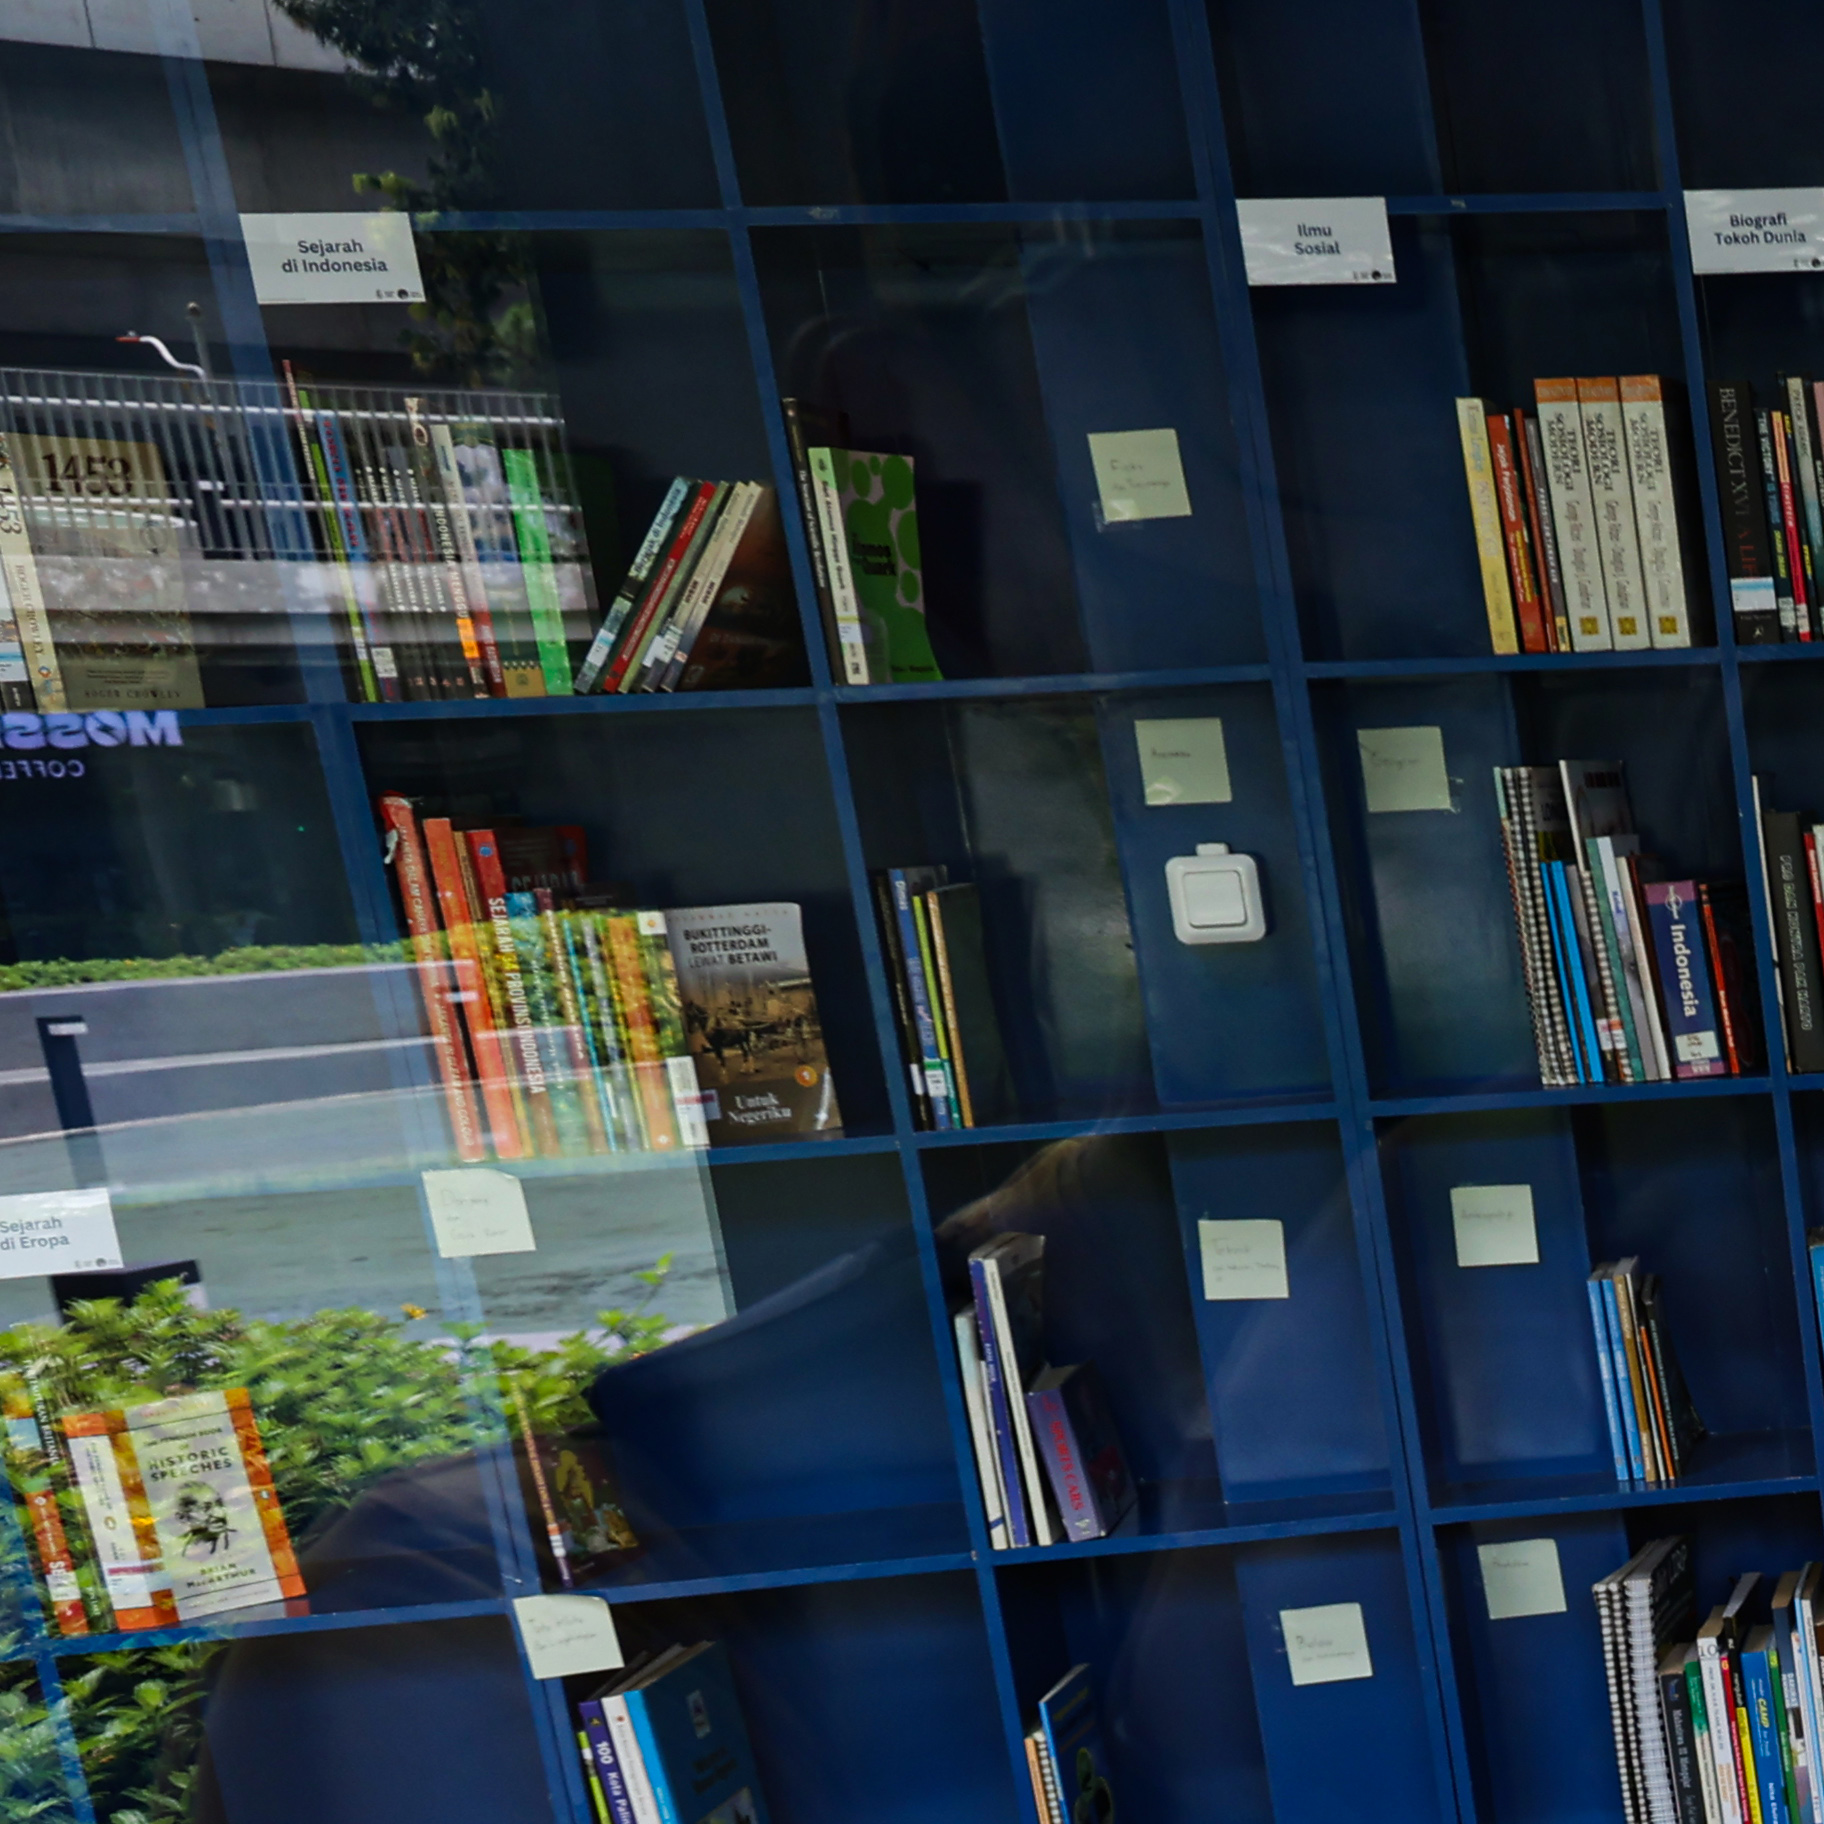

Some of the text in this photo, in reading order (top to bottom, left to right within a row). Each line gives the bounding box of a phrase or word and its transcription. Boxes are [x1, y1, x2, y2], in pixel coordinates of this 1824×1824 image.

[1297, 223, 1332, 238] Ilmu
[1729, 212, 1788, 231] Biografi
[298, 240, 363, 257] Sejarah
[1294, 241, 1341, 256] Sosial
[1714, 230, 1806, 246] Tokoh Dunia
[282, 258, 388, 273] di Indonesia
[1555, 412, 1573, 491] SOSIOLOGI
[1566, 428, 1581, 474] TEORI
[1594, 413, 1612, 491] SOSIOLOGI
[1605, 428, 1620, 474] TEORI
[1719, 386, 1744, 474] BENEDICT
[1738, 544, 1756, 579] LIF
[893, 879, 909, 910] Dimas
[690, 939, 769, 954] ROTTERDAM
[1779, 854, 1812, 1031] PRO DAN KONTRA PAK HARTO
[728, 952, 777, 965] BETAWI
[1669, 923, 1699, 1018] Indonesia
[487, 895, 546, 1095] SEJARAH 34 PROVINSI INDONESIA
[735, 1092, 779, 1109] Untuk
[0, 1217, 62, 1235] Sejarah
[0, 1235, 70, 1251] di Eropa
[149, 1447, 228, 1470] HISTORIC
[150, 1459, 232, 1482] SPEECHES
[1064, 1473, 1085, 1511] CARS
[1756, 1696, 1769, 1728] CAMP
[594, 1739, 613, 1765] 100
[606, 1770, 623, 1796] Kota
